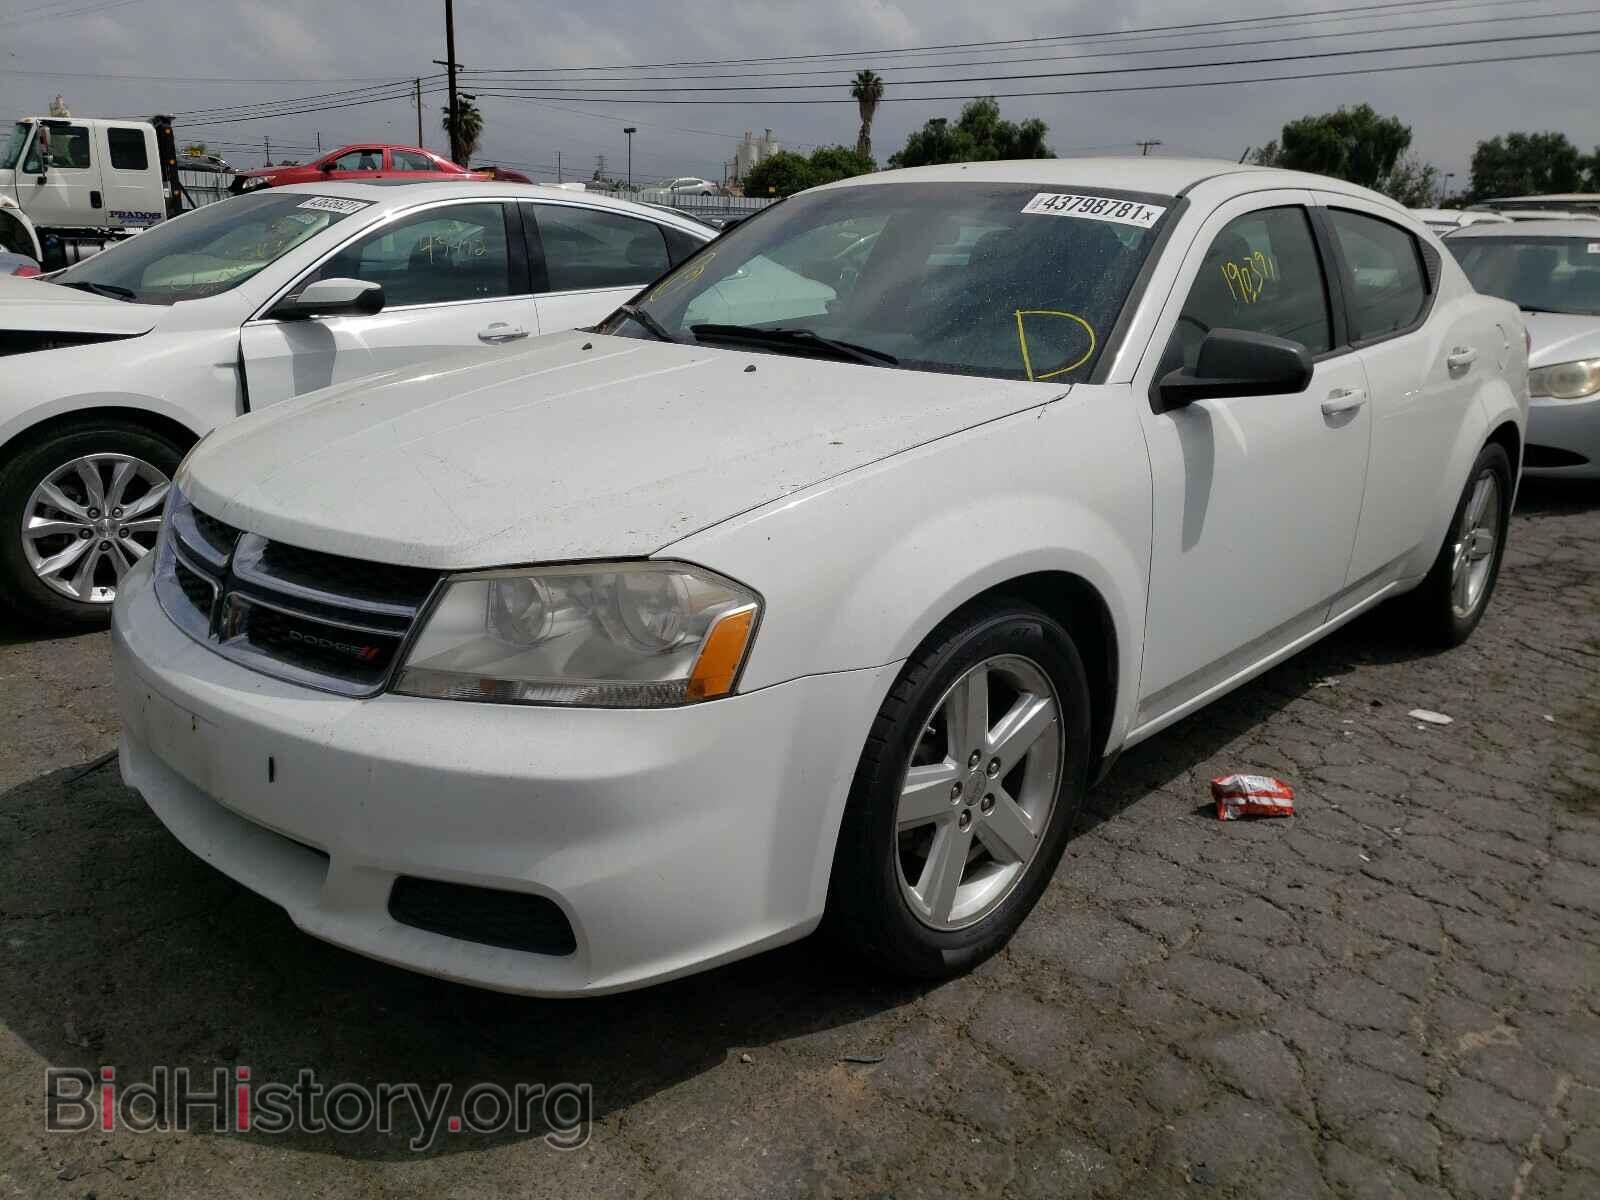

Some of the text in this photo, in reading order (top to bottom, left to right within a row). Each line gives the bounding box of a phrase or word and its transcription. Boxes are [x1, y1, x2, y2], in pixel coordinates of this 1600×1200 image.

[109, 211, 161, 220] PRADOS
[1013, 308, 1096, 382] D
[289, 630, 361, 656] DODGE
